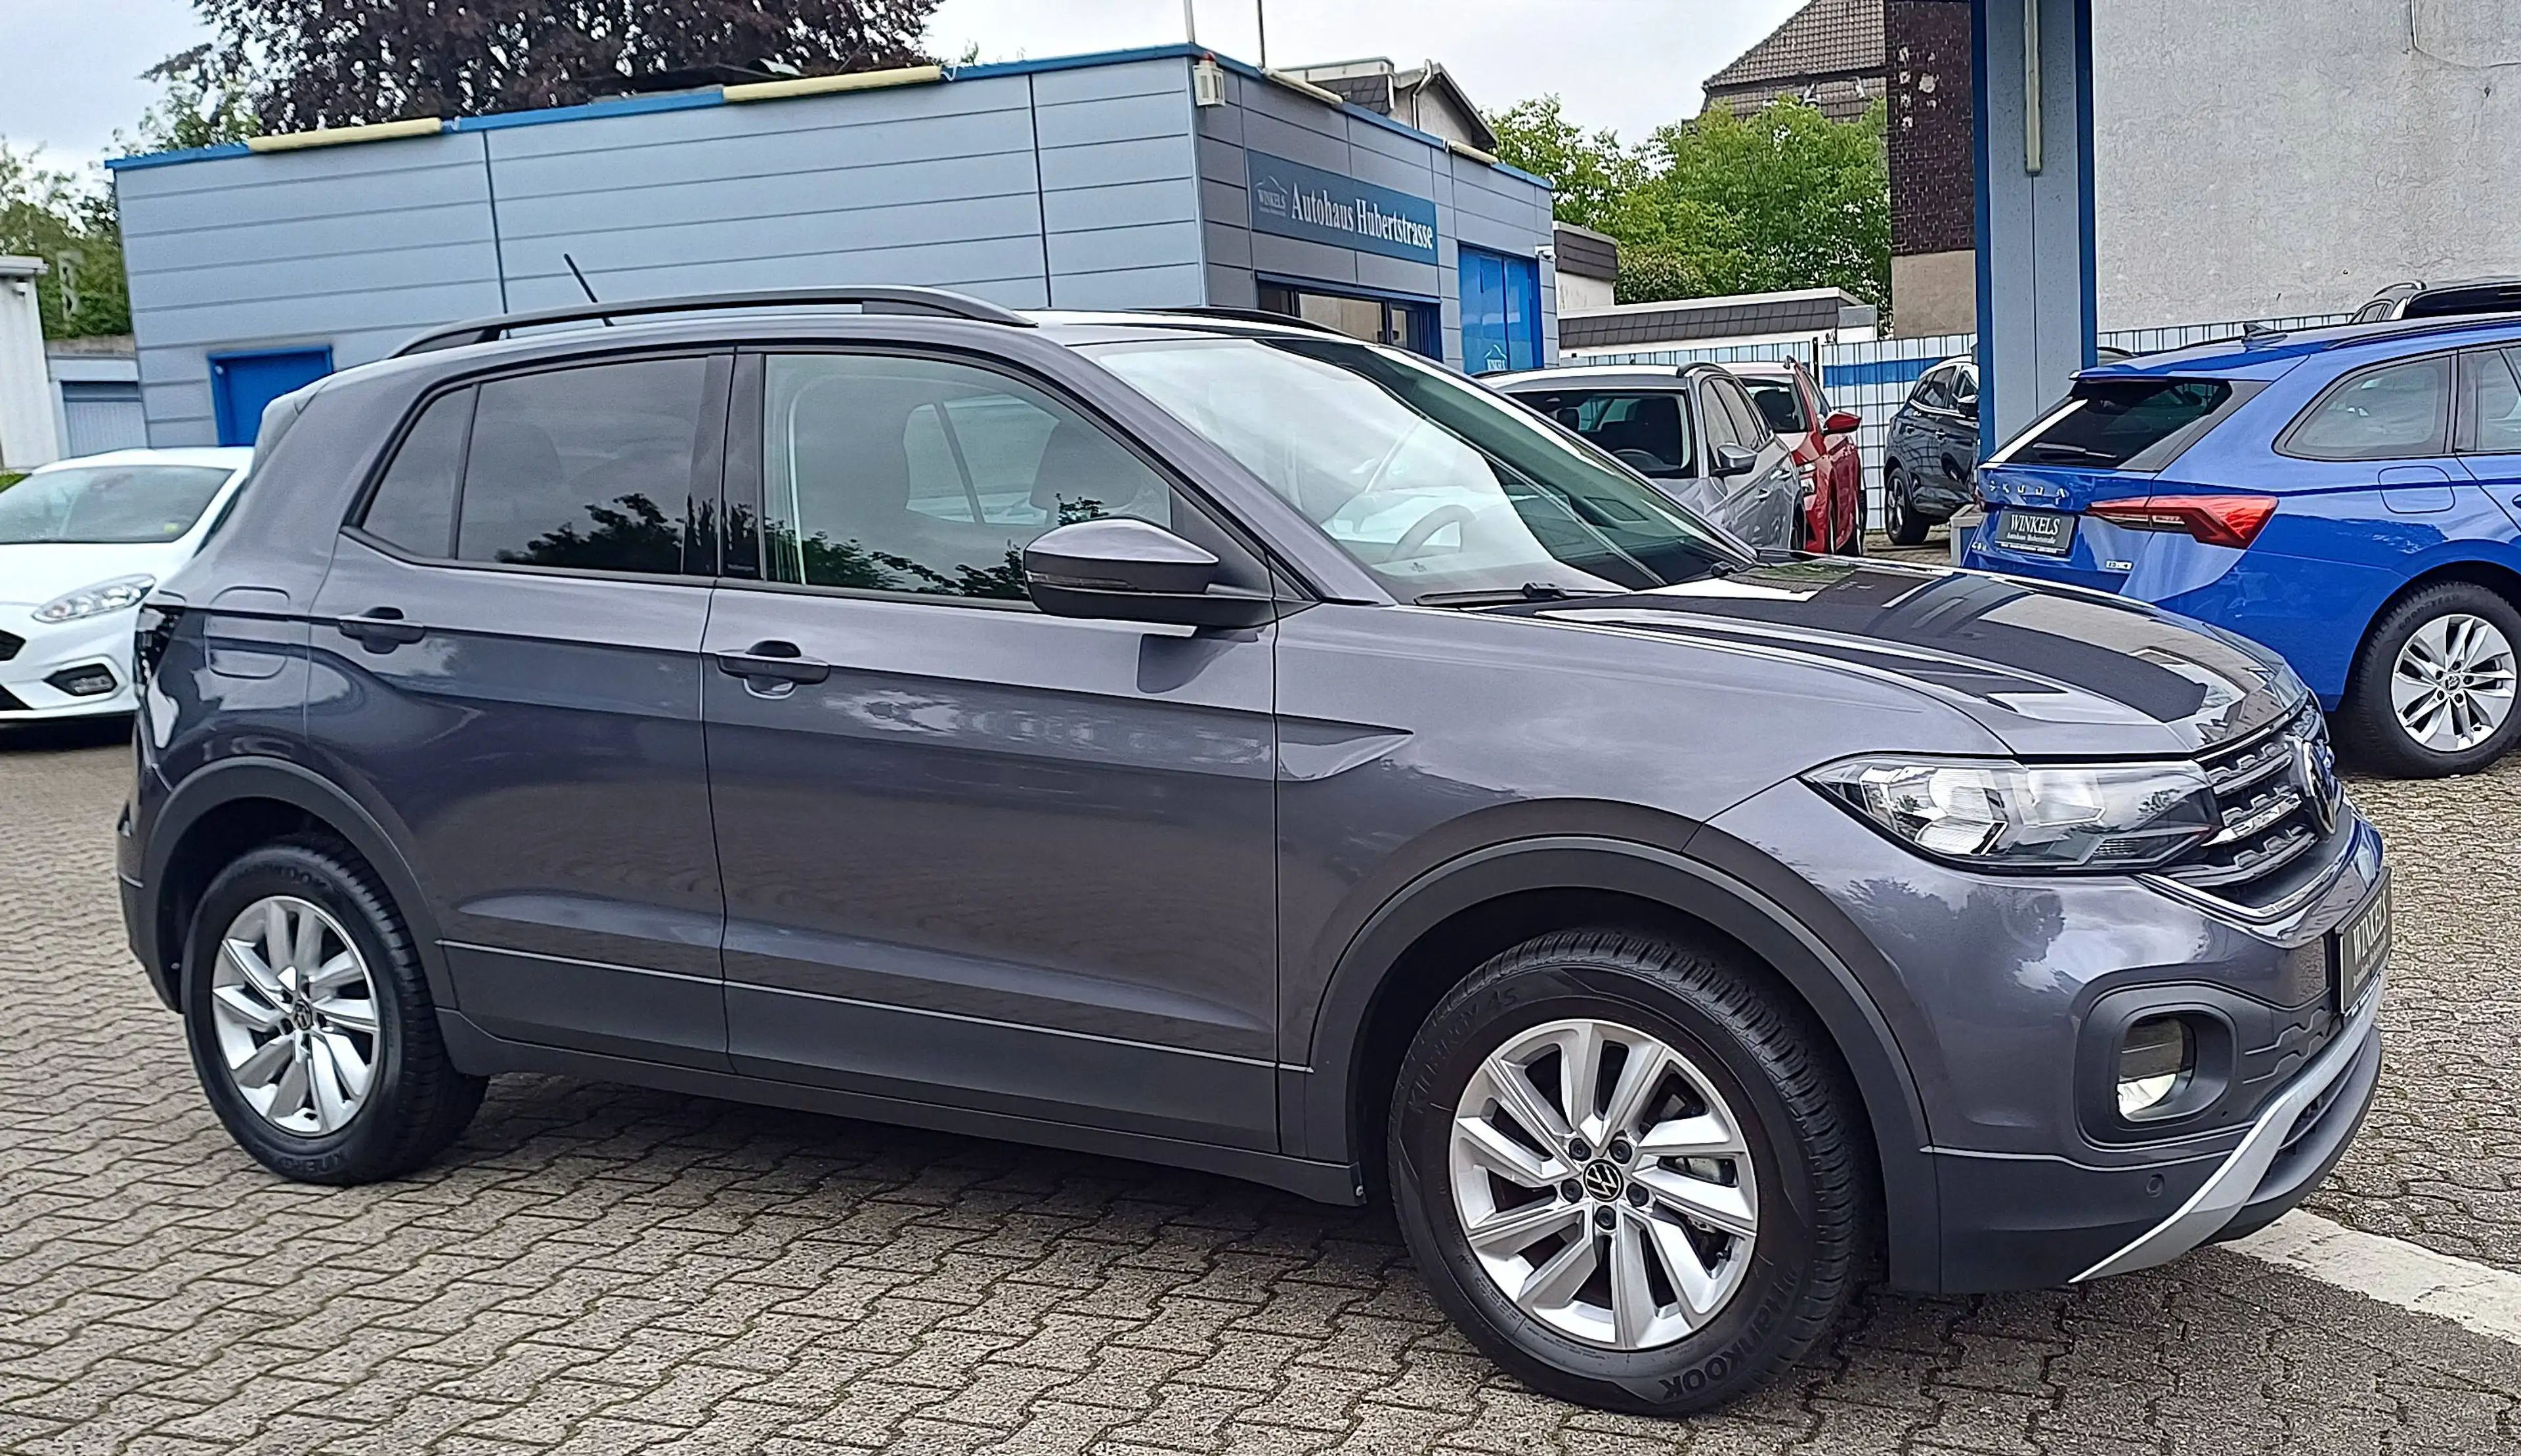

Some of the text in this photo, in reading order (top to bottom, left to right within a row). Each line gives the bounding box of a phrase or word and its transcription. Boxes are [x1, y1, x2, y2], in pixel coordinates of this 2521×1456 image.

[1291, 181, 1433, 251] Autohaus Hubertstrasse
[2010, 514, 2060, 536] WINKELS
[2353, 889, 2387, 966] WINKELS
